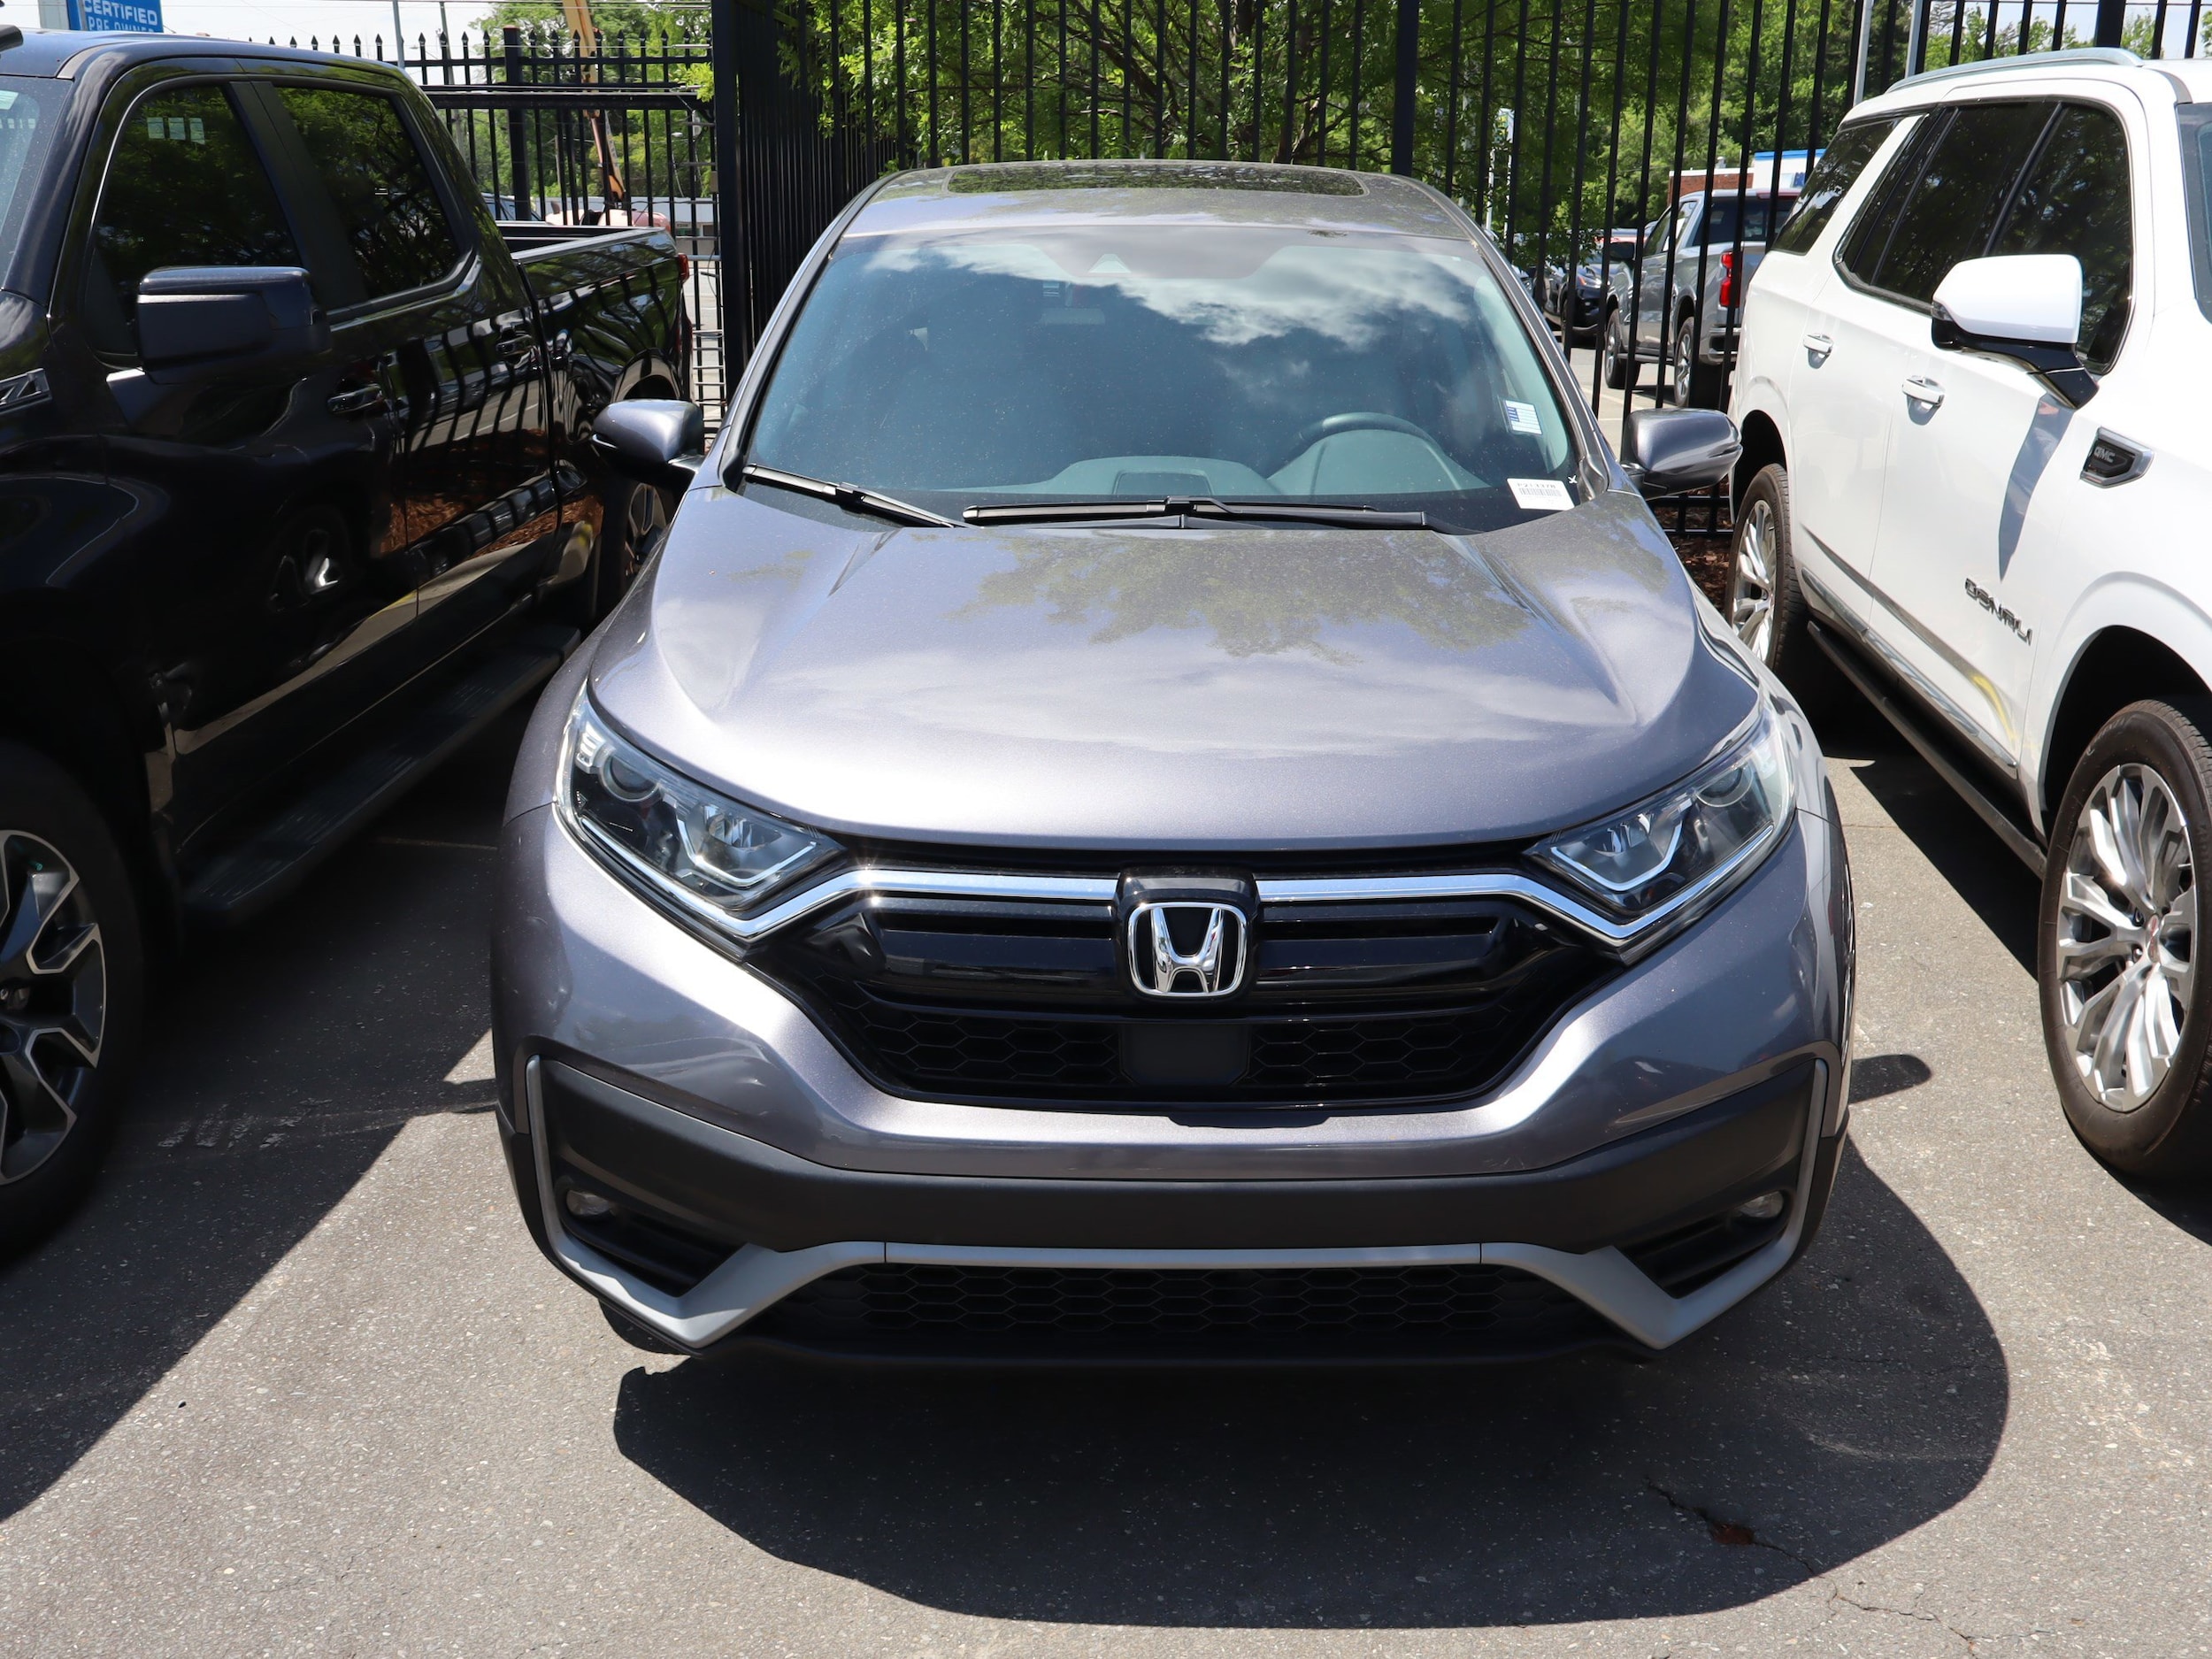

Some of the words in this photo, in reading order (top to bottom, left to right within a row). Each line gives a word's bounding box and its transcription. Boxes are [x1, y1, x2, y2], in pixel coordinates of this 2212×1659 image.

[84, 0, 157, 26] CERTIFIED
[2093, 446, 2116, 463] GMC
[1965, 578, 2032, 646] DENALI
